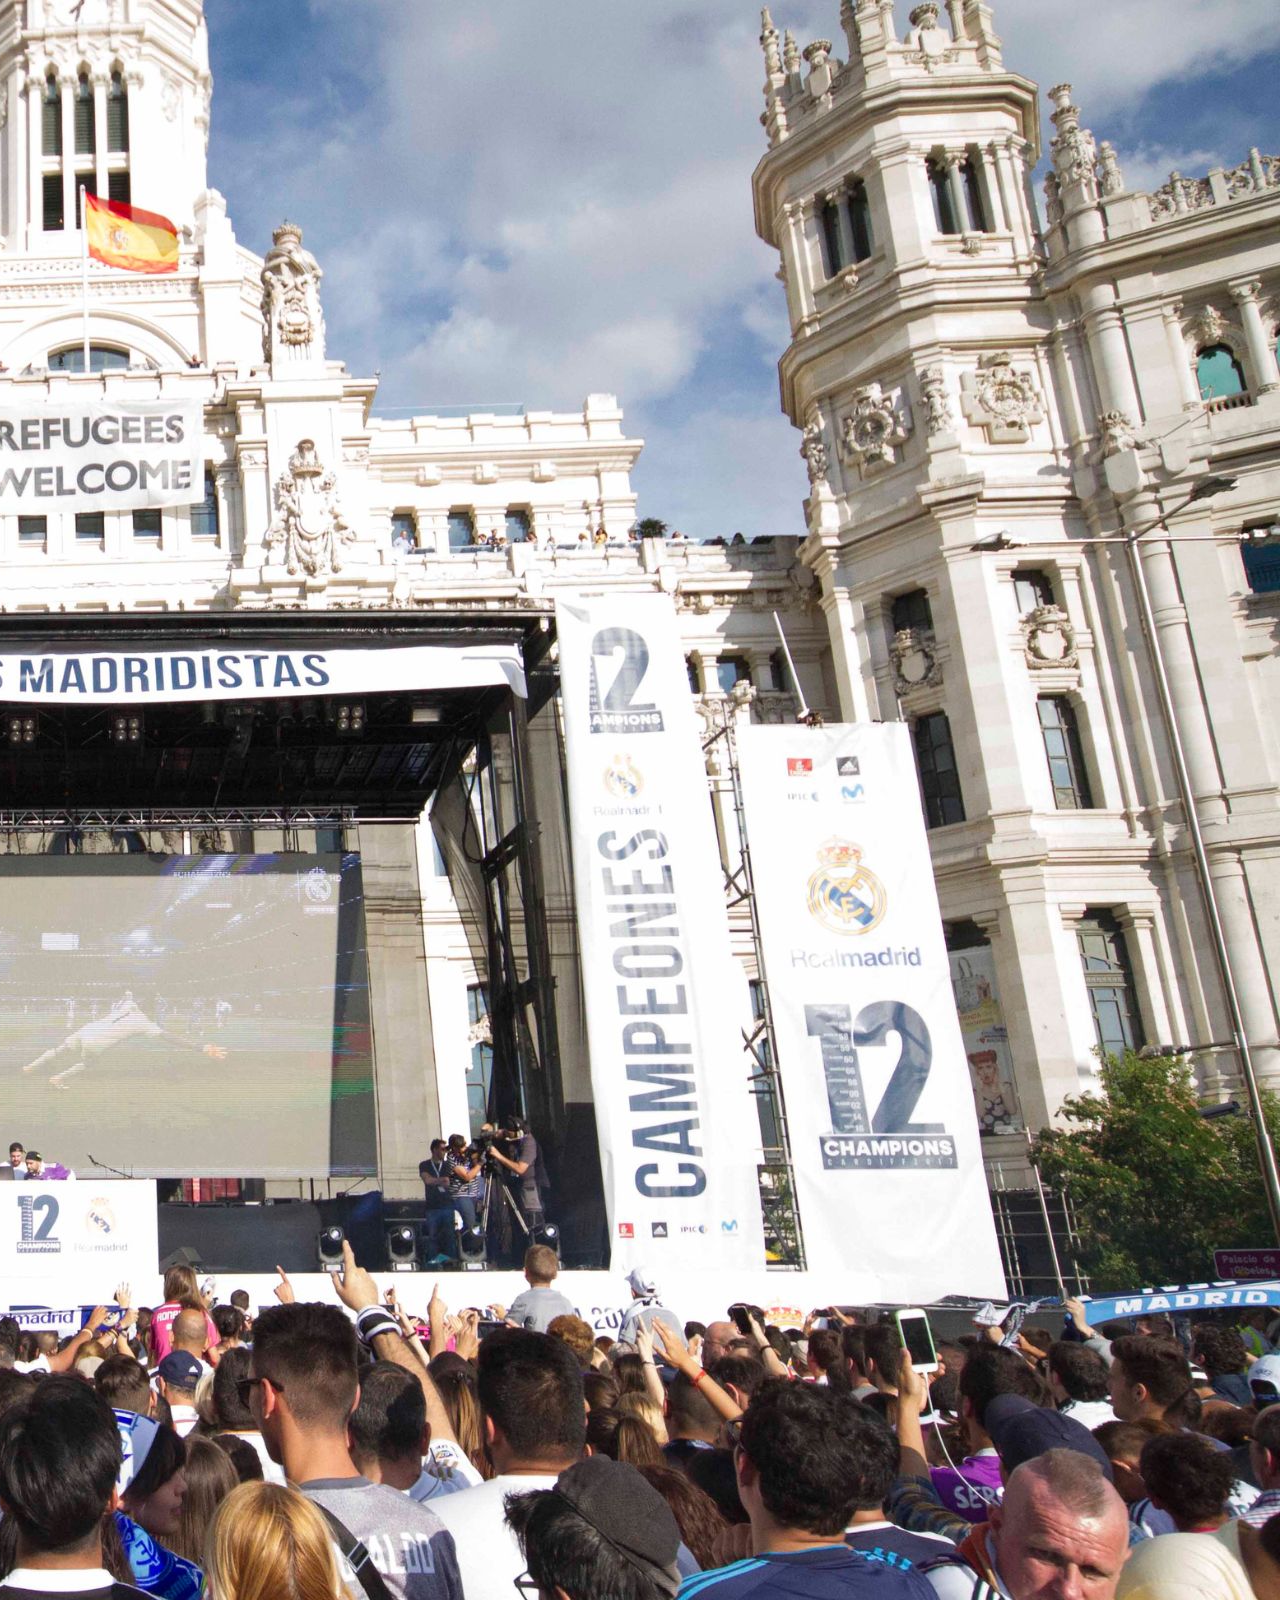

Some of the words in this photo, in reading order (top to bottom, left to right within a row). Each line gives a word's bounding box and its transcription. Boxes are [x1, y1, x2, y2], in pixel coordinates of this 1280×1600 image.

[19, 654, 330, 694] MADRIDISTAS
[589, 626, 656, 711] 2
[591, 713, 662, 726] AMPIONS
[791, 946, 922, 968] Realmadrid
[597, 829, 708, 1198] CAMPEONES
[803, 1000, 946, 1135] 12
[823, 1139, 954, 1157] CHAMPIONS
[17, 1194, 60, 1242] 12
[1222, 1254, 1258, 1264] Palacio
[1262, 1254, 1276, 1264] de
[1114, 1290, 1269, 1315] MADRID
